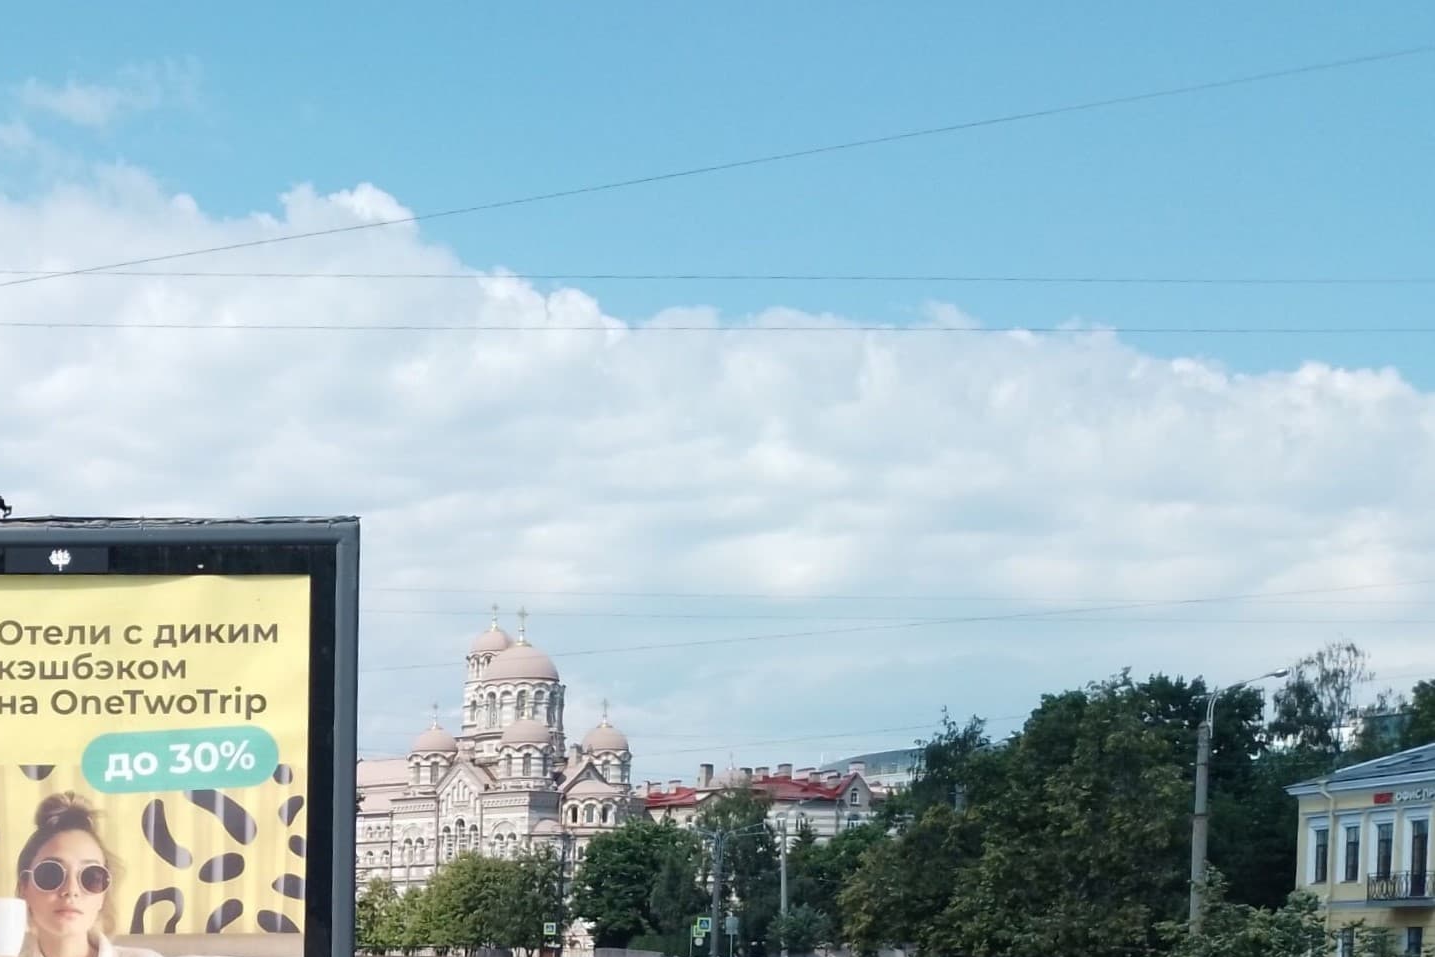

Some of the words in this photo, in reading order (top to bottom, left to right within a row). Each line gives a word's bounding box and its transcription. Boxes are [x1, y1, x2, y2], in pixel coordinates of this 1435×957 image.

[124, 624, 143, 644] с
[153, 623, 278, 648] диким
[50, 686, 267, 720] OneTwoTrip
[104, 750, 158, 782] до
[168, 739, 256, 774] 30%
